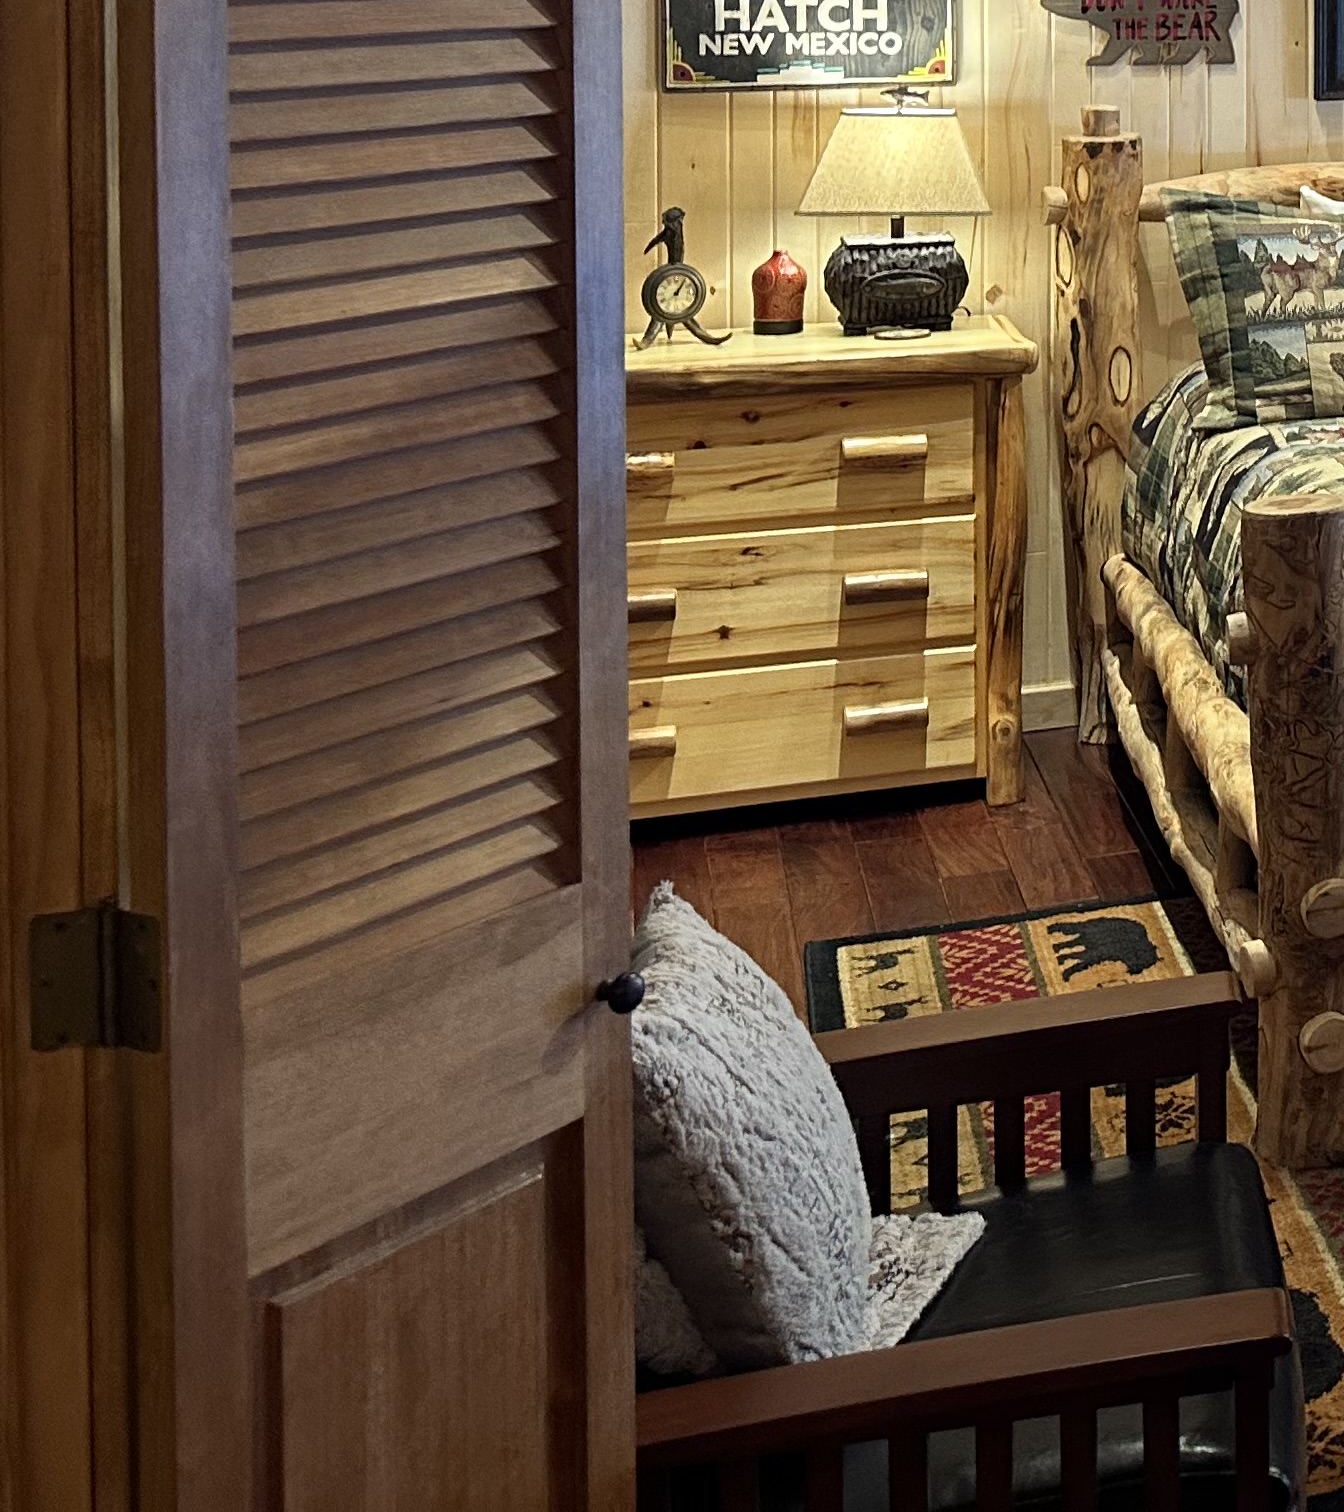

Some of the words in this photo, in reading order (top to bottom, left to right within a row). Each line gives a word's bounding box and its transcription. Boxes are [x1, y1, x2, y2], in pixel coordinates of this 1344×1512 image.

[1112, 17, 1148, 40] THE
[1155, 11, 1221, 42] BEAR
[699, 32, 775, 57] NEW
[785, 31, 903, 57] MEXICO
